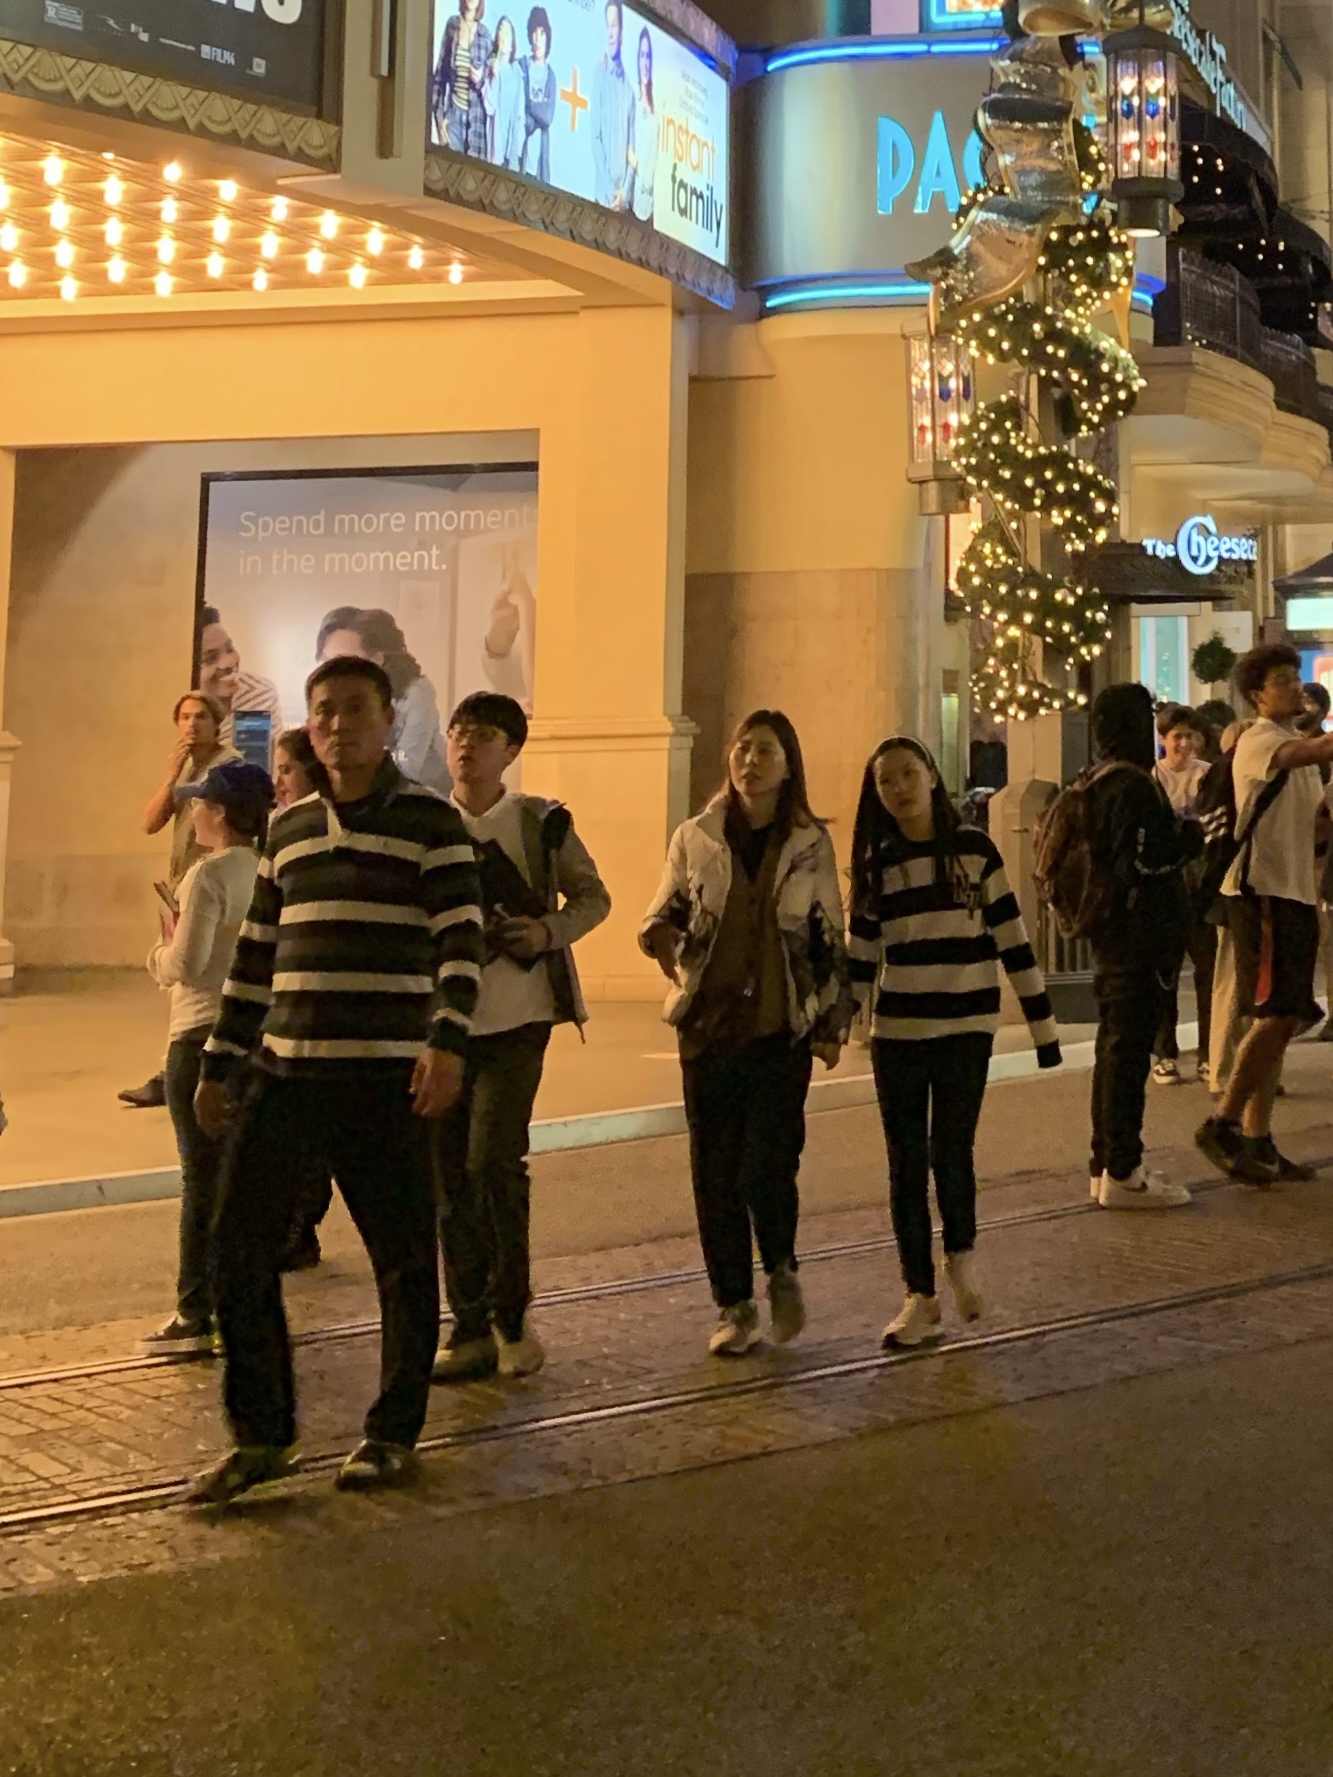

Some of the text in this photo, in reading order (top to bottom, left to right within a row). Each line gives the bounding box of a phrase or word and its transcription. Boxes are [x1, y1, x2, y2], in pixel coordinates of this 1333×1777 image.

[661, 100, 716, 183] instant
[670, 162, 724, 249] family
[238, 509, 326, 542] Spend
[333, 512, 406, 536] more
[238, 544, 448, 575] in the moment.
[1141, 537, 1177, 560] The
